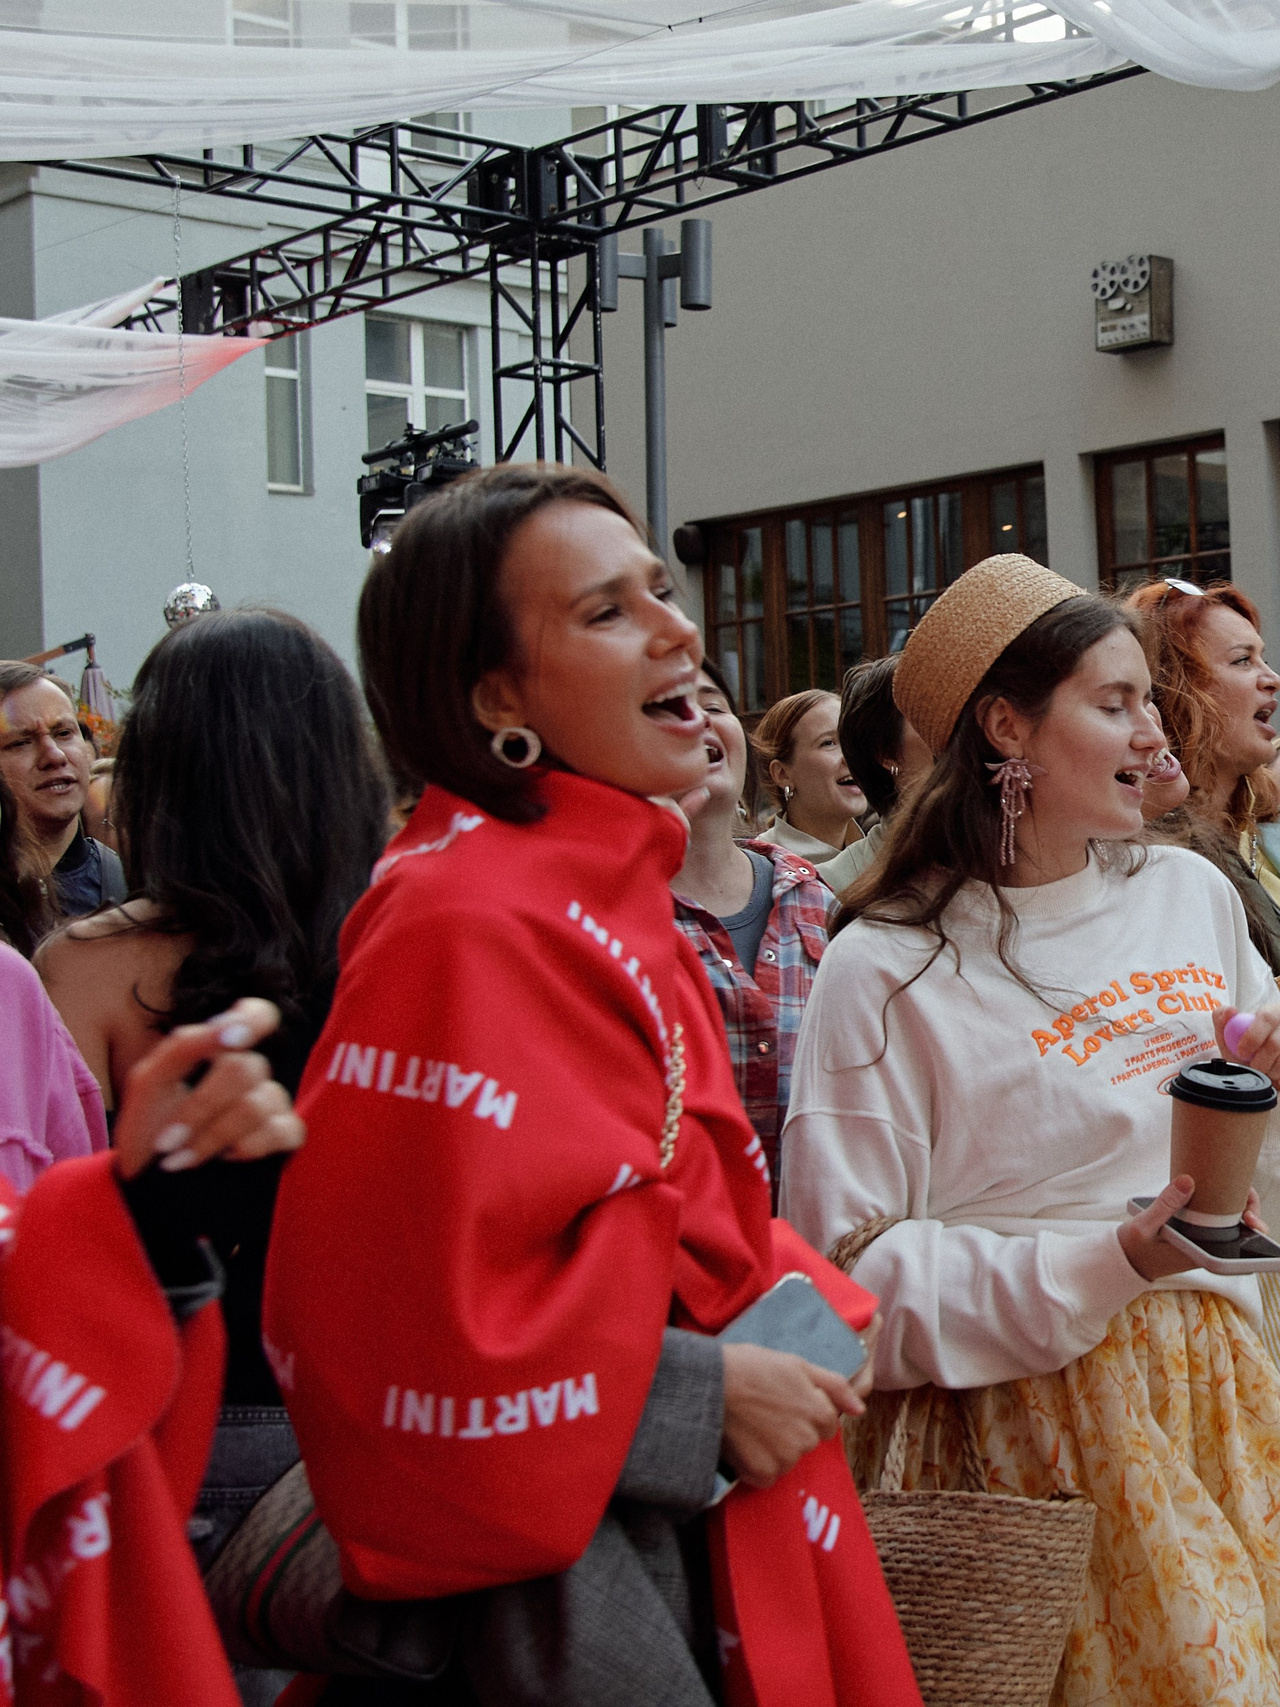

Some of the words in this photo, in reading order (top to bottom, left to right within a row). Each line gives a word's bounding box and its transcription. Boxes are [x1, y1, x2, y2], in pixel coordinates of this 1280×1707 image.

[1031, 980, 1130, 1057] Aperol
[1129, 962, 1226, 994] Spritz
[1062, 1008, 1155, 1067] Lovers
[1157, 991, 1221, 1015] Club
[1150, 1032, 1174, 1046] NEED:
[326, 1041, 518, 1130] MARTINI
[1116, 1068, 1142, 1082] PARTS
[1181, 1044, 1200, 1059] PART
[1130, 1050, 1156, 1065] PARTS
[383, 1372, 599, 1439] MARTINI
